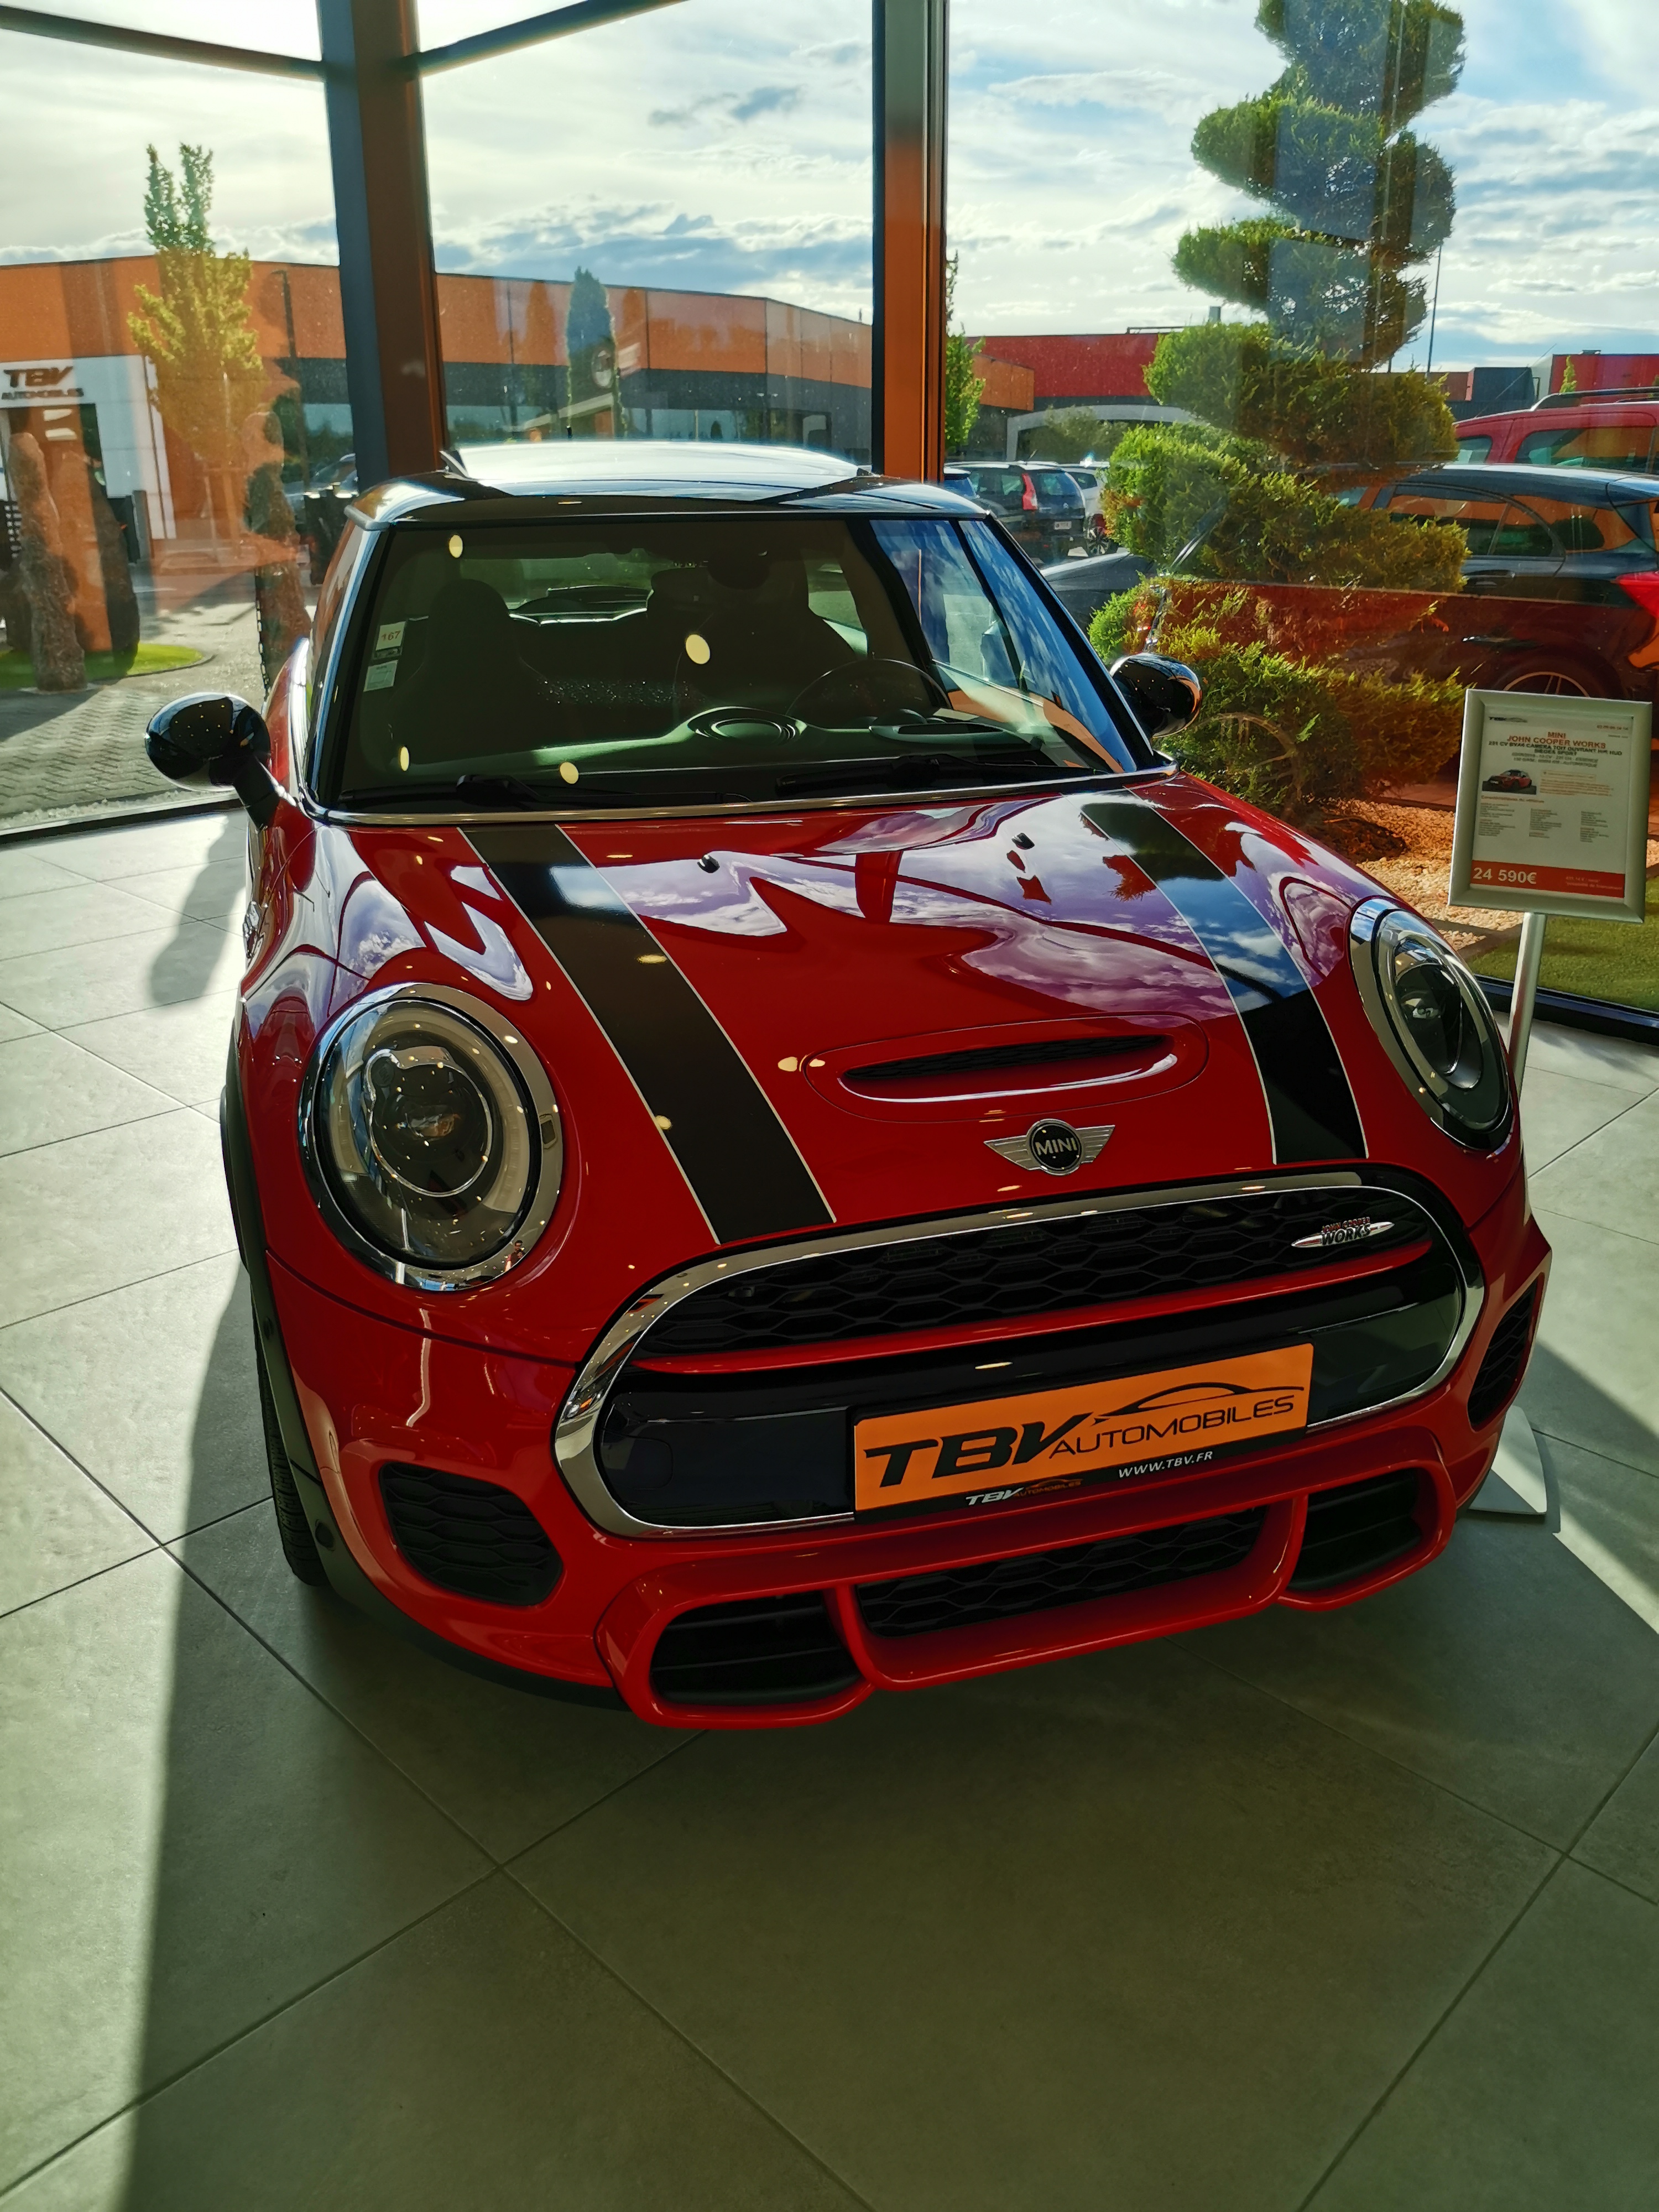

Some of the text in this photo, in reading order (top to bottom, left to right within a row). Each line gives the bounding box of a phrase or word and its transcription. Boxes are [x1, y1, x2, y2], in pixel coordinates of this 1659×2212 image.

[3, 366, 73, 388] TBV
[381, 630, 401, 641] 167
[1533, 737, 1571, 746] COOPER
[1572, 740, 1606, 749] WORKS
[1473, 867, 1537, 885] 24 590€
[1035, 1137, 1078, 1156] MINI
[1321, 1222, 1371, 1245] WORKS
[863, 1395, 1295, 1488] TBV AUTOMOBILES
[965, 1451, 1213, 1506] TBV AUTOMOBILES WWW.TBV.FR
